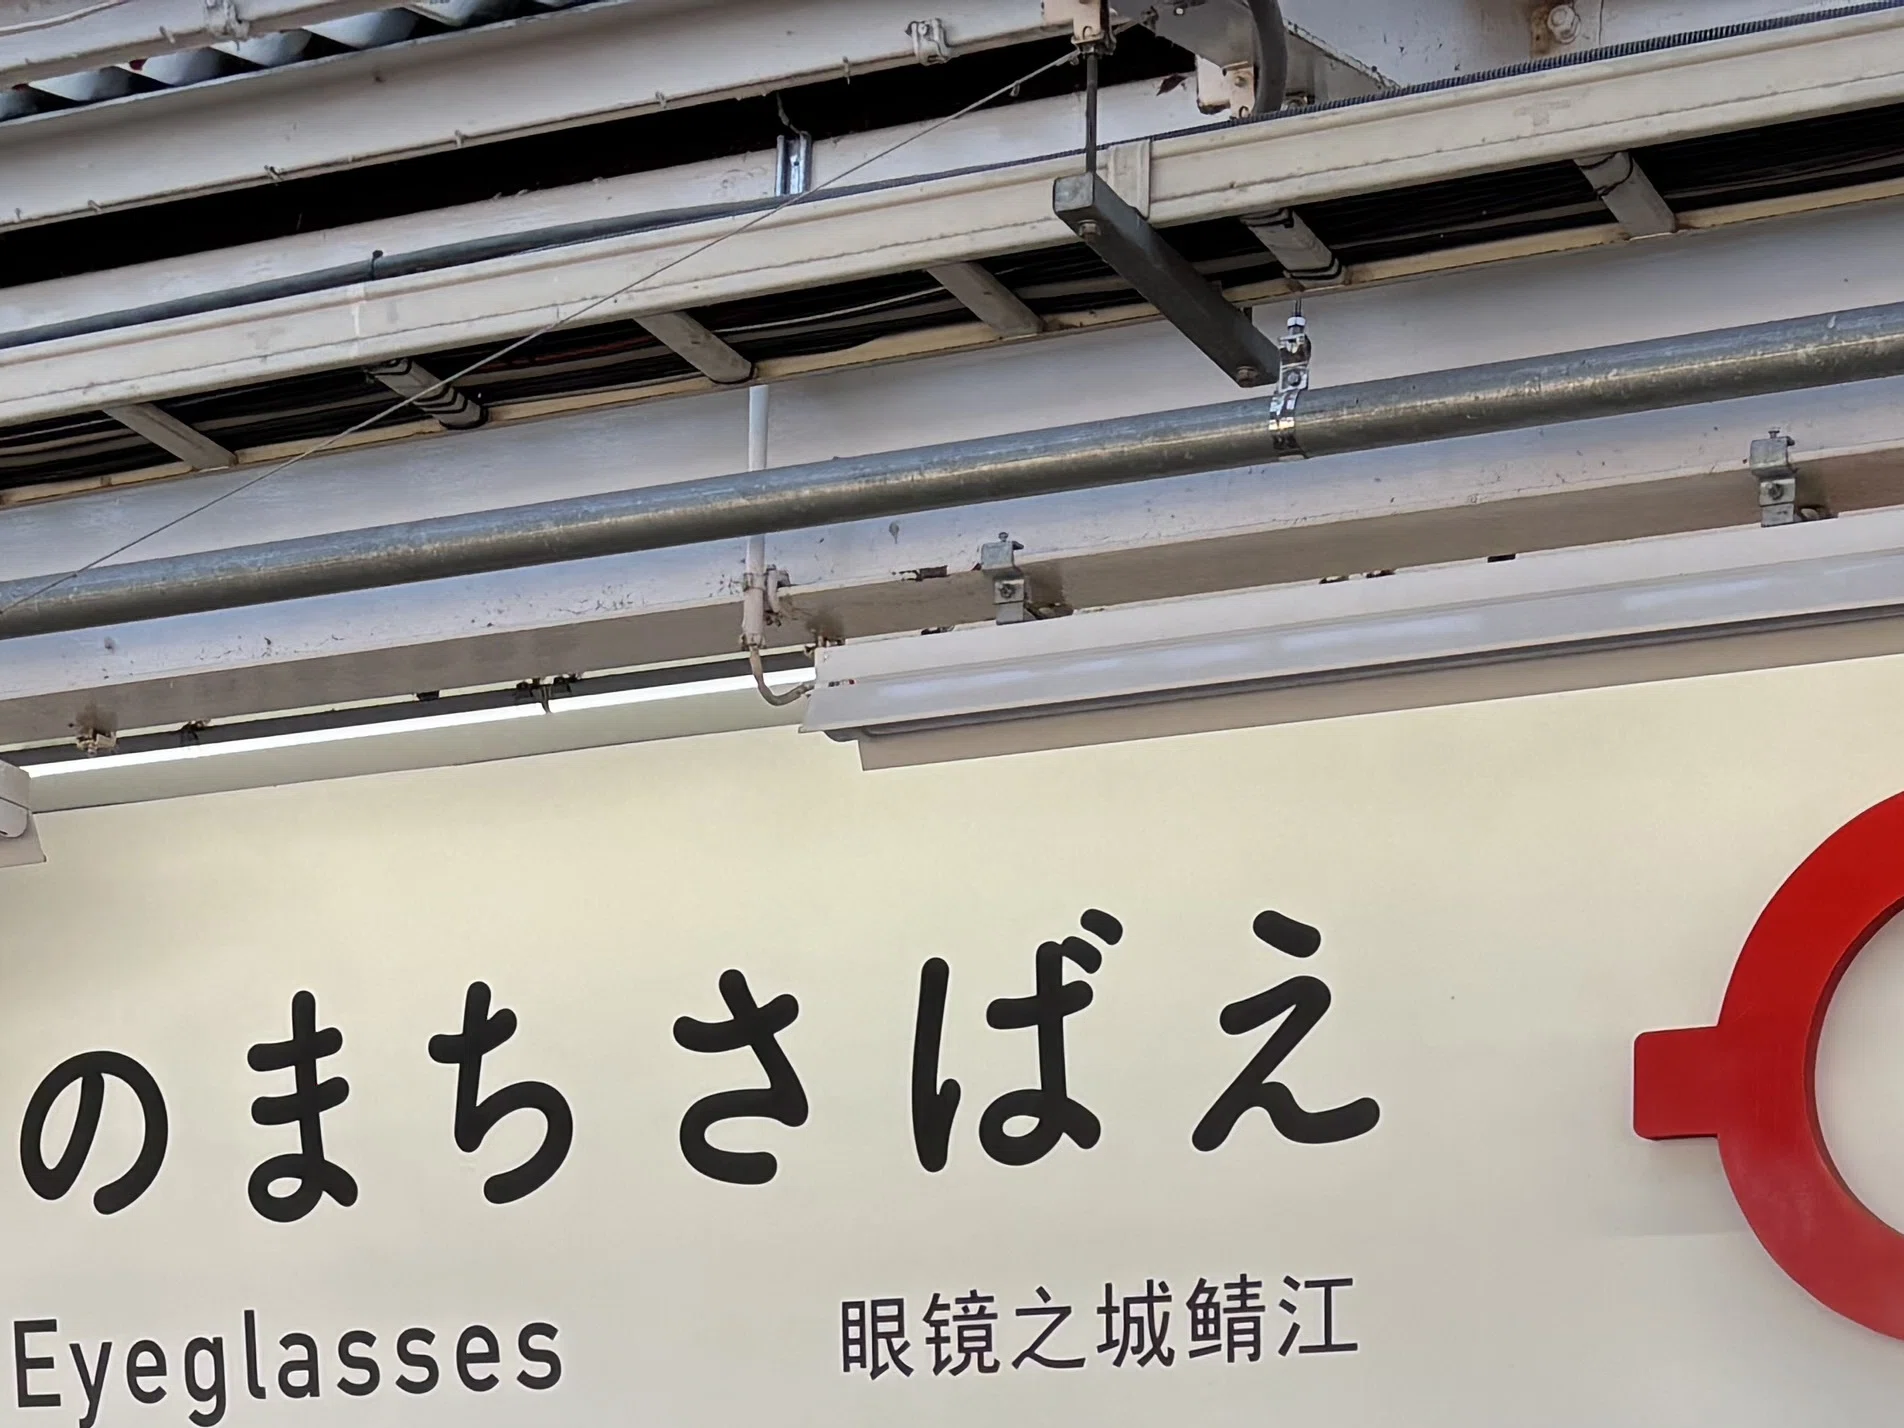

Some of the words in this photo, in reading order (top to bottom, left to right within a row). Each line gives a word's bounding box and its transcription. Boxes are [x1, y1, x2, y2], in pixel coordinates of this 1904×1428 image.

[841, 1272, 1360, 1381] 眼镜之城鲭江
